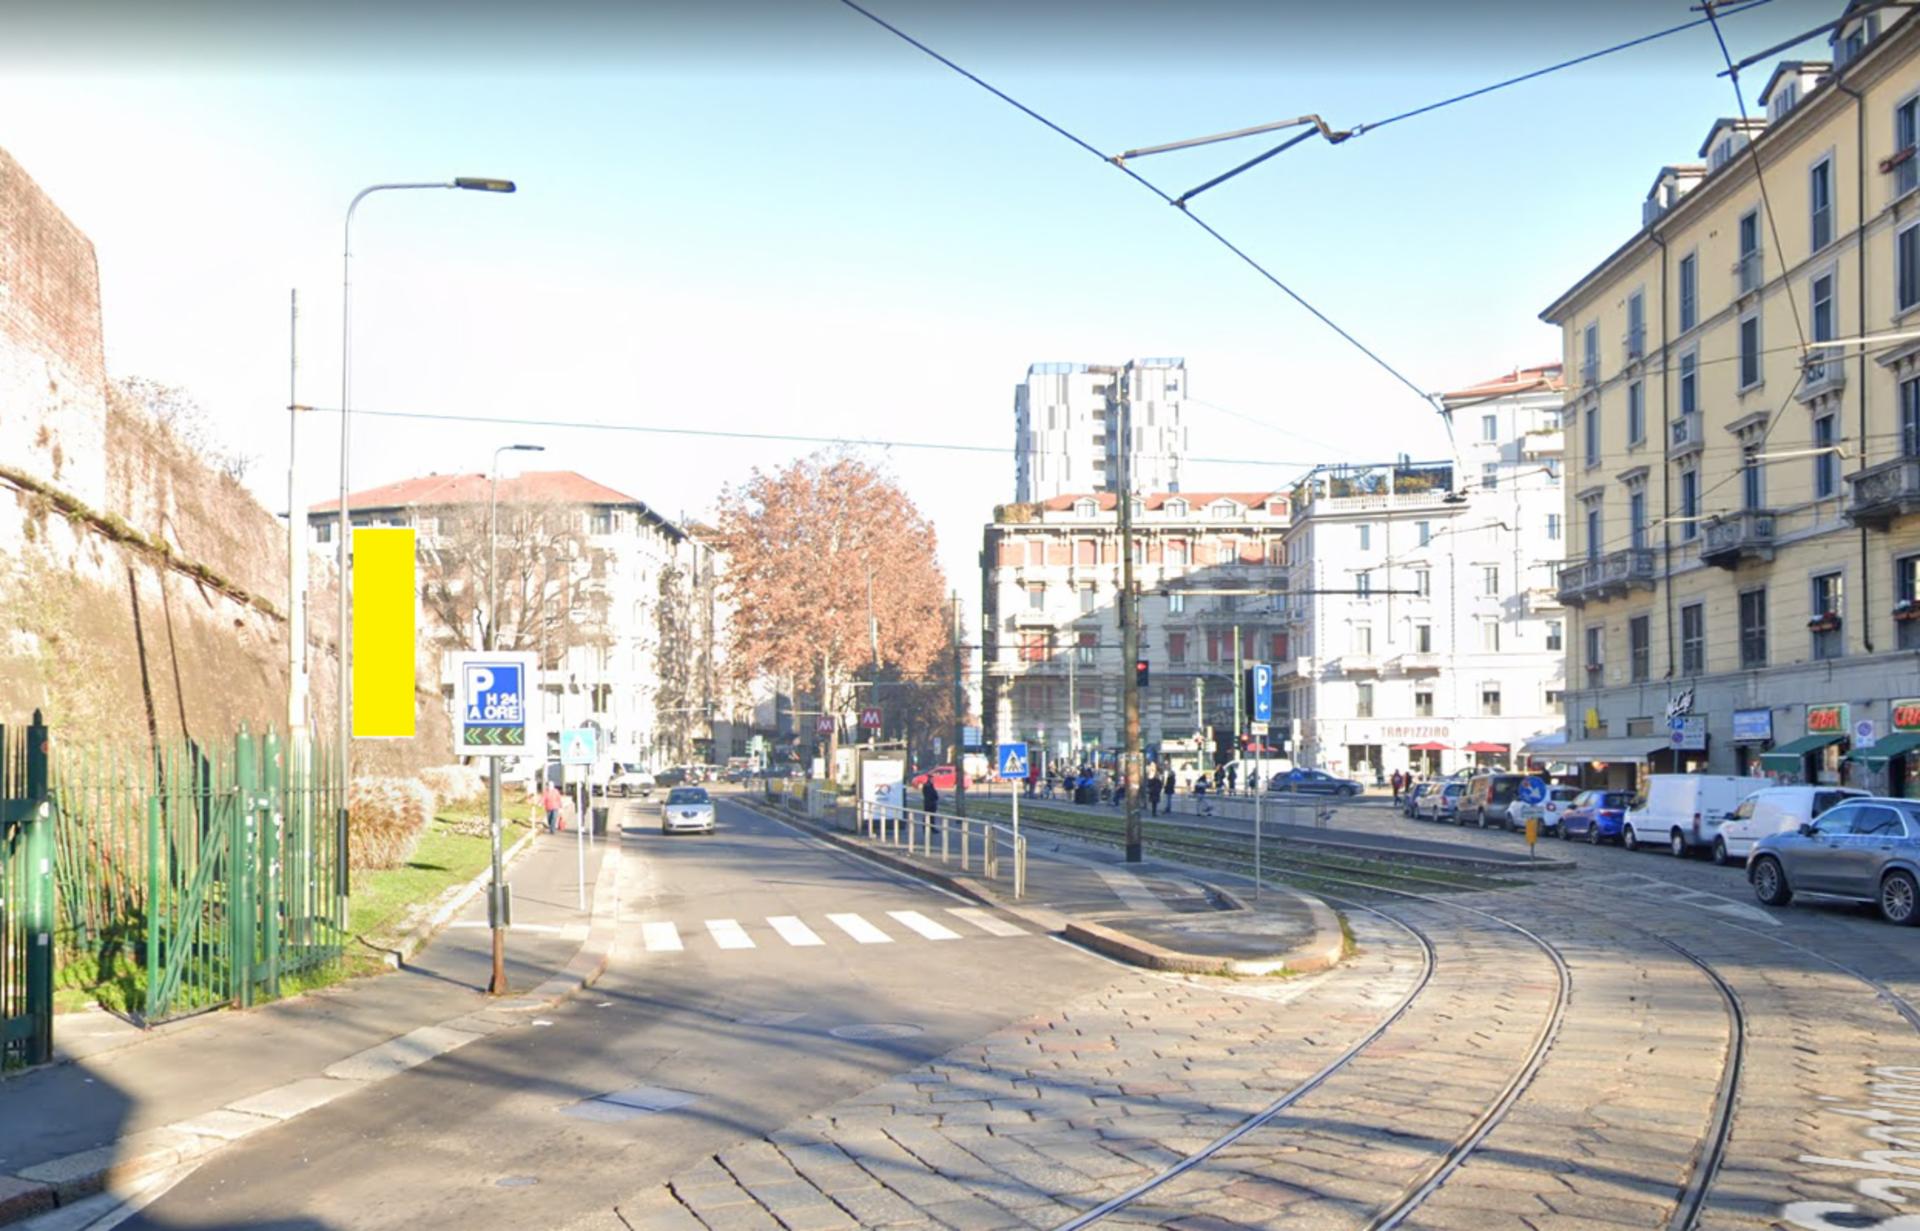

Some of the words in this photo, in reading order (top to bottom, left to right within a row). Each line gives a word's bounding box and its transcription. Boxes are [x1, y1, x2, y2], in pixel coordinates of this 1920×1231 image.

[468, 669, 494, 705] P
[1258, 669, 1268, 695] P
[486, 693, 498, 705] H
[500, 692, 518, 705] 24
[469, 705, 481, 719] A
[484, 705, 518, 719] ORE
[864, 711, 880, 724] M
[820, 720, 832, 730] M
